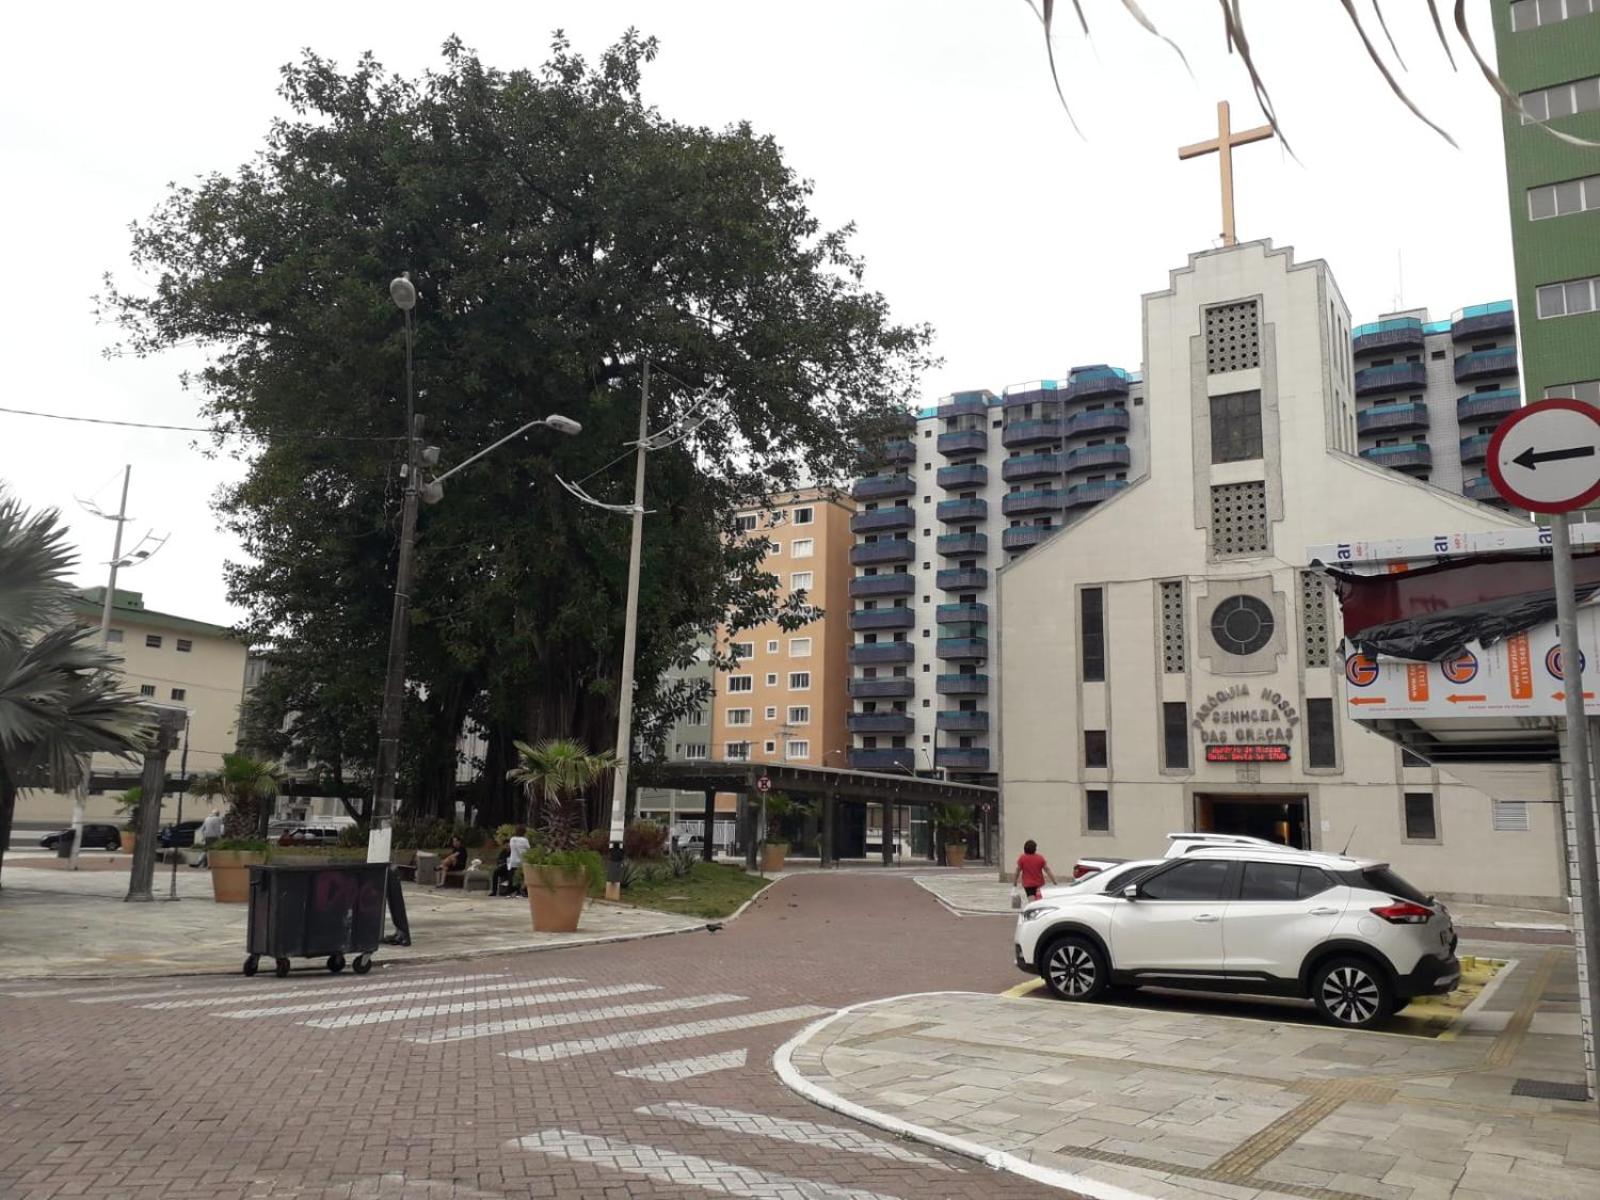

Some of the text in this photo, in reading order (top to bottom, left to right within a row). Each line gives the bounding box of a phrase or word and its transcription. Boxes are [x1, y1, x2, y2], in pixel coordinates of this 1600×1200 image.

[1260, 687, 1300, 727] NOSSA
[1212, 709, 1281, 725] SENHORA
[1200, 727, 1294, 743] DAS GRAÇAS
